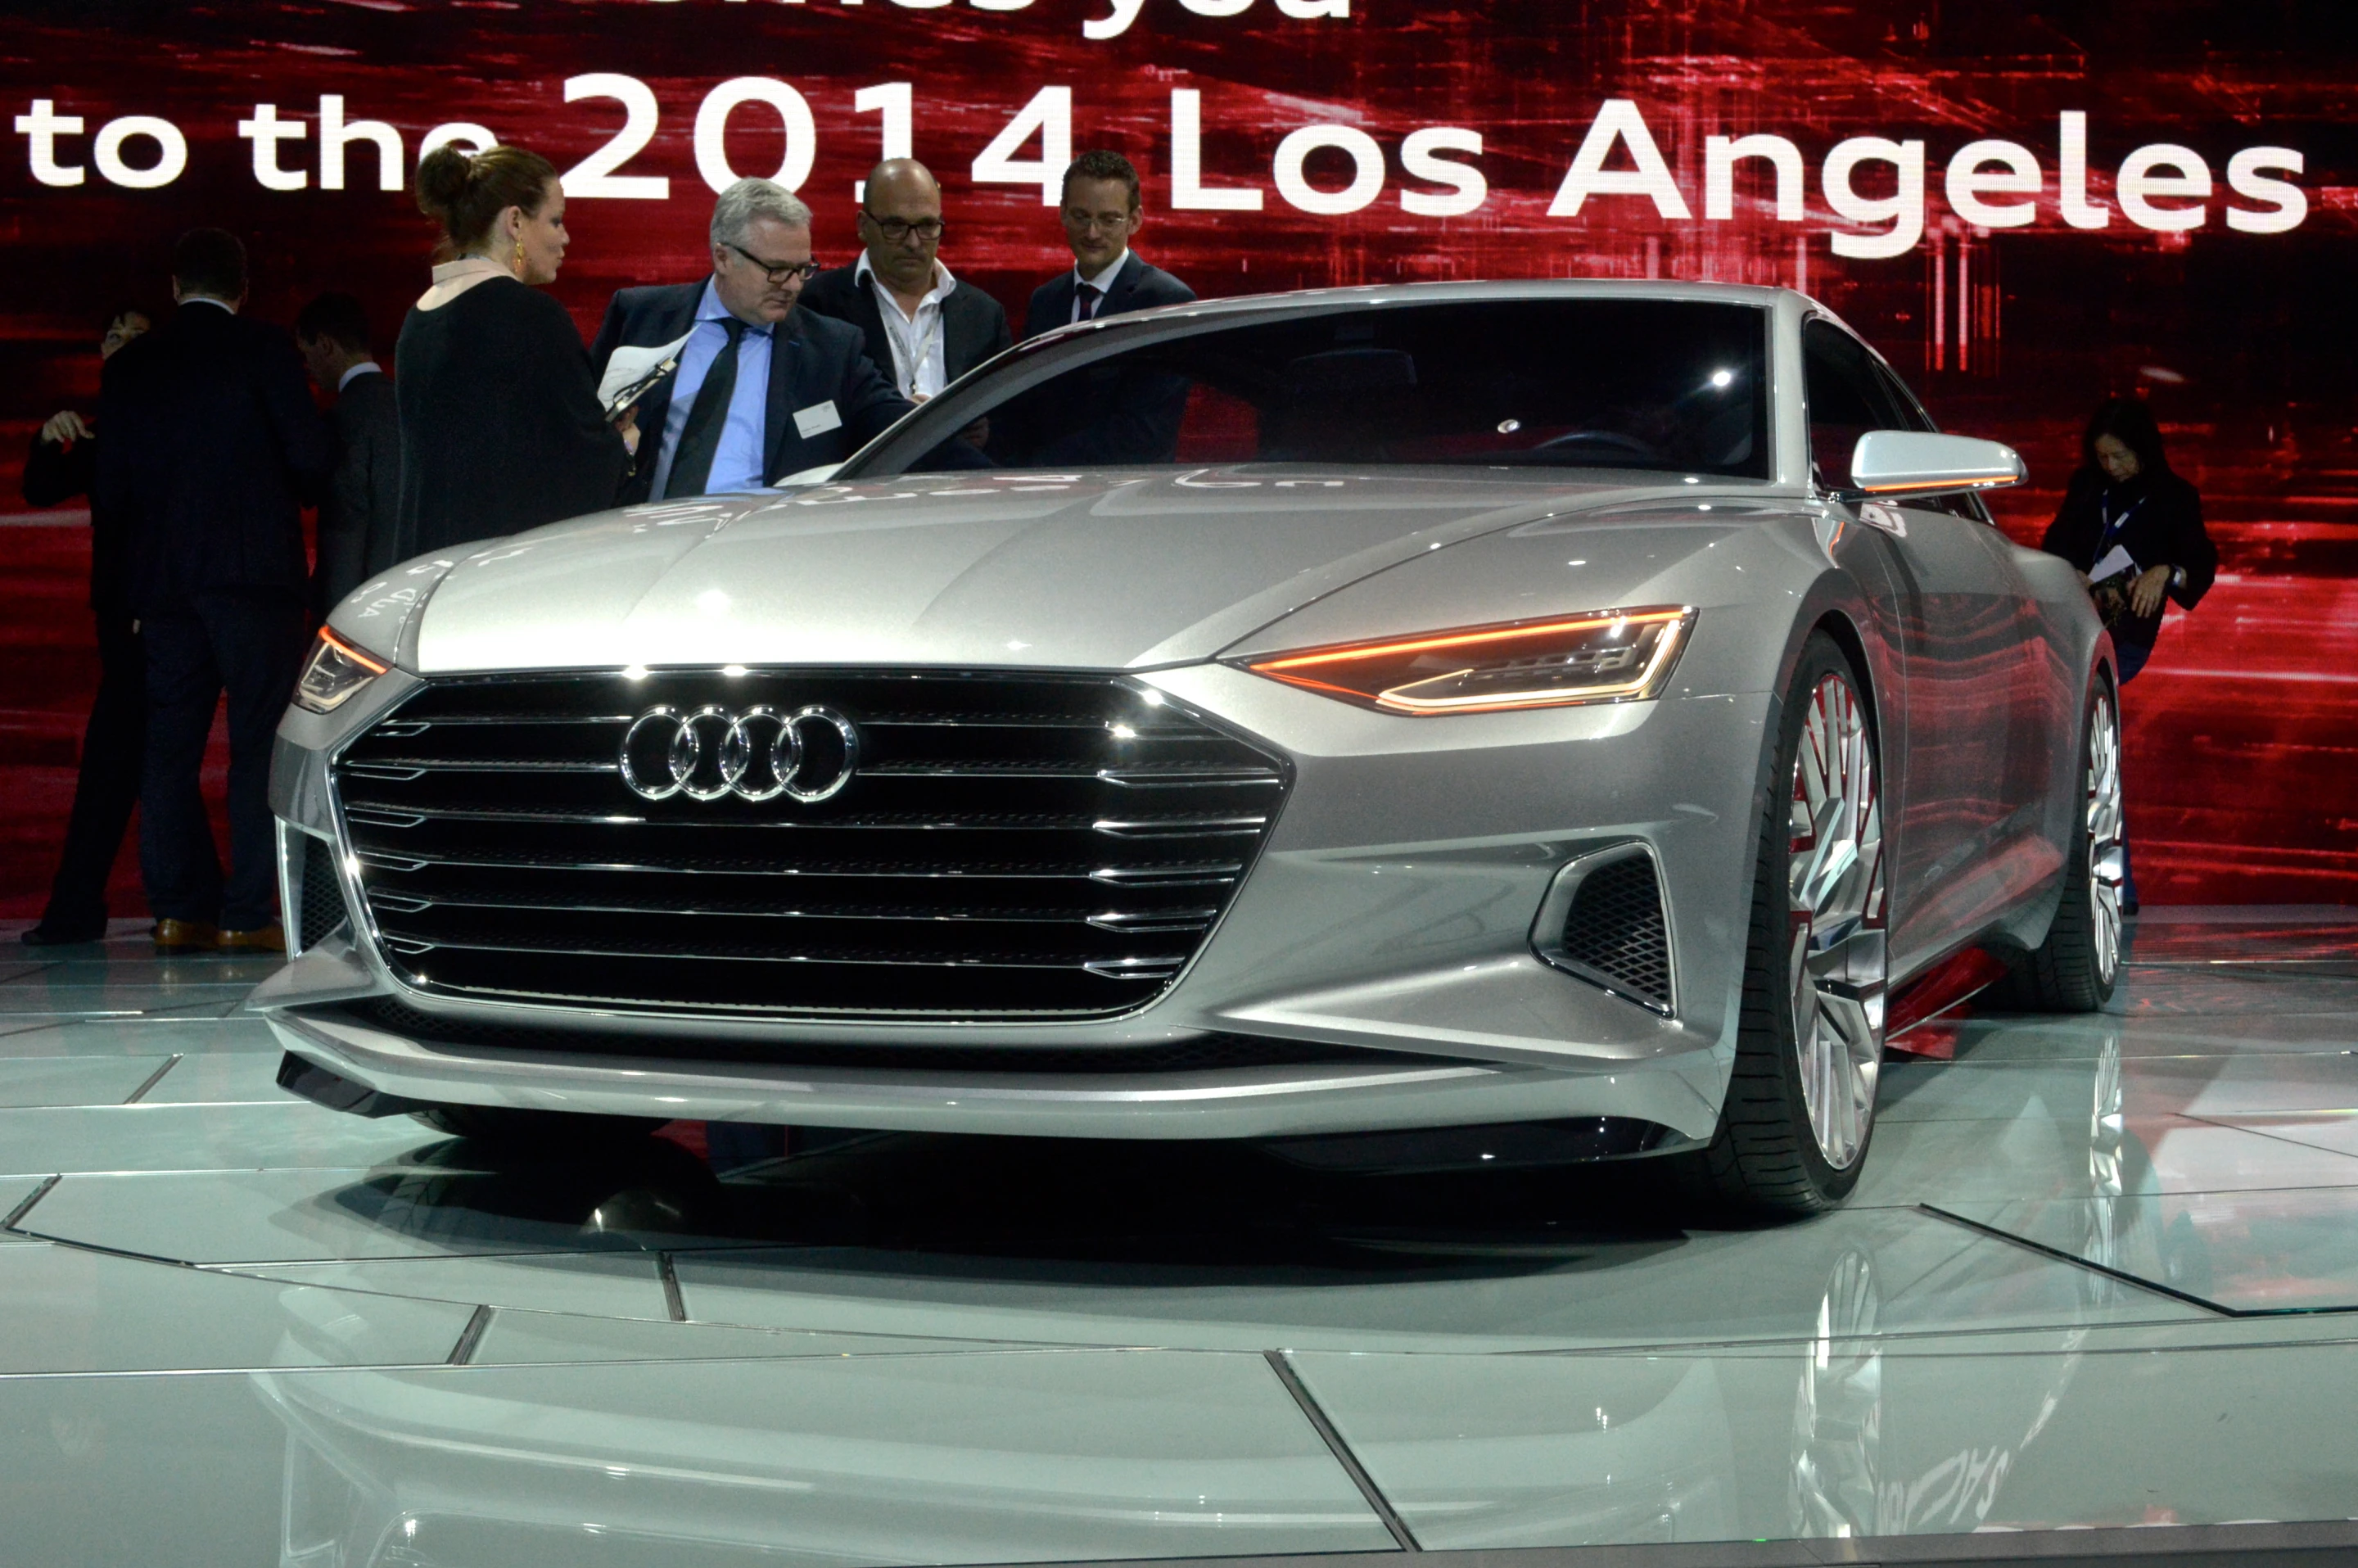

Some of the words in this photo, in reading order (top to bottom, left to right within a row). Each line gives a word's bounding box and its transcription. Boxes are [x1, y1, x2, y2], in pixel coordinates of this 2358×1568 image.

[15, 99, 187, 188] to
[558, 73, 1072, 207] 2014
[1171, 88, 1488, 217] Los
[1546, 99, 2308, 259] Angeles
